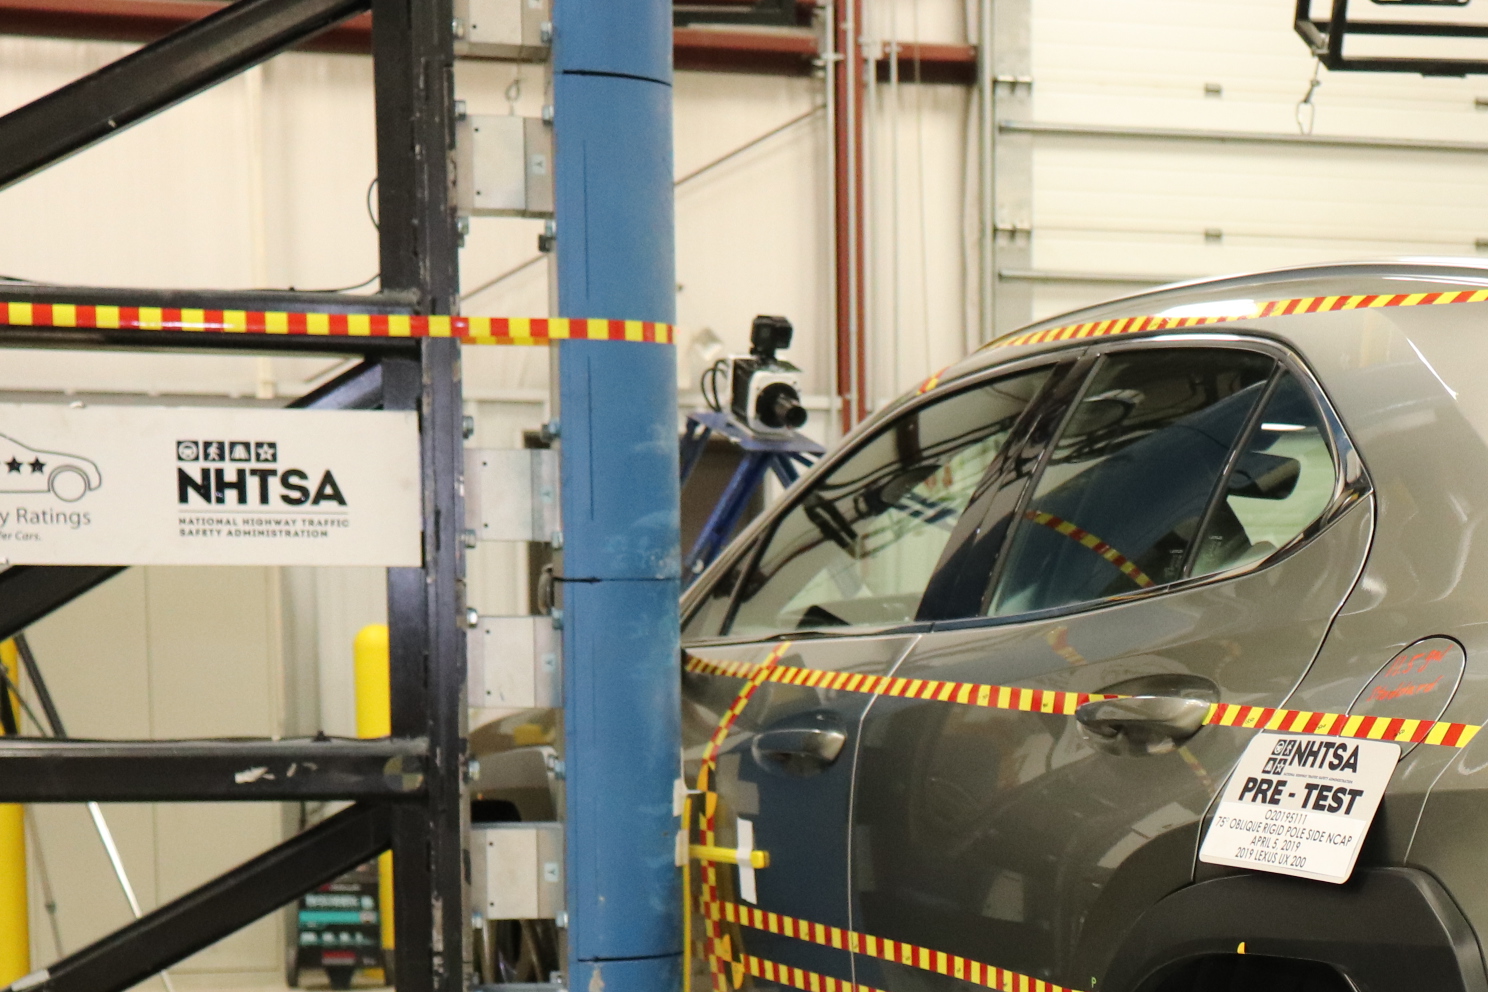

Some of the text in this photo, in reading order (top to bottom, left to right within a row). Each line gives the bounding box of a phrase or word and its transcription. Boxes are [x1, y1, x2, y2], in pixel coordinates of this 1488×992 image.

[177, 468, 348, 506] NHTSA
[16, 507, 91, 529] Ratings
[179, 517, 350, 528] NATIONAL HIGHWAY TRAFFIC
[179, 529, 328, 538] SAFETY ADMINISTRATION
[1288, 740, 1360, 773] NHTSA
[1238, 776, 1288, 805] PRE
[1300, 783, 1364, 815] TEST
[1229, 818, 1262, 834] OBLIQUE
[1262, 823, 1285, 836] RIGID
[1285, 826, 1306, 840] POLE
[1305, 829, 1326, 842] SIDE
[1326, 832, 1353, 847] NCAP
[1250, 836, 1301, 852] APRIL 5, 2019
[1235, 847, 1307, 868] 2019 LEXUS UX 200
